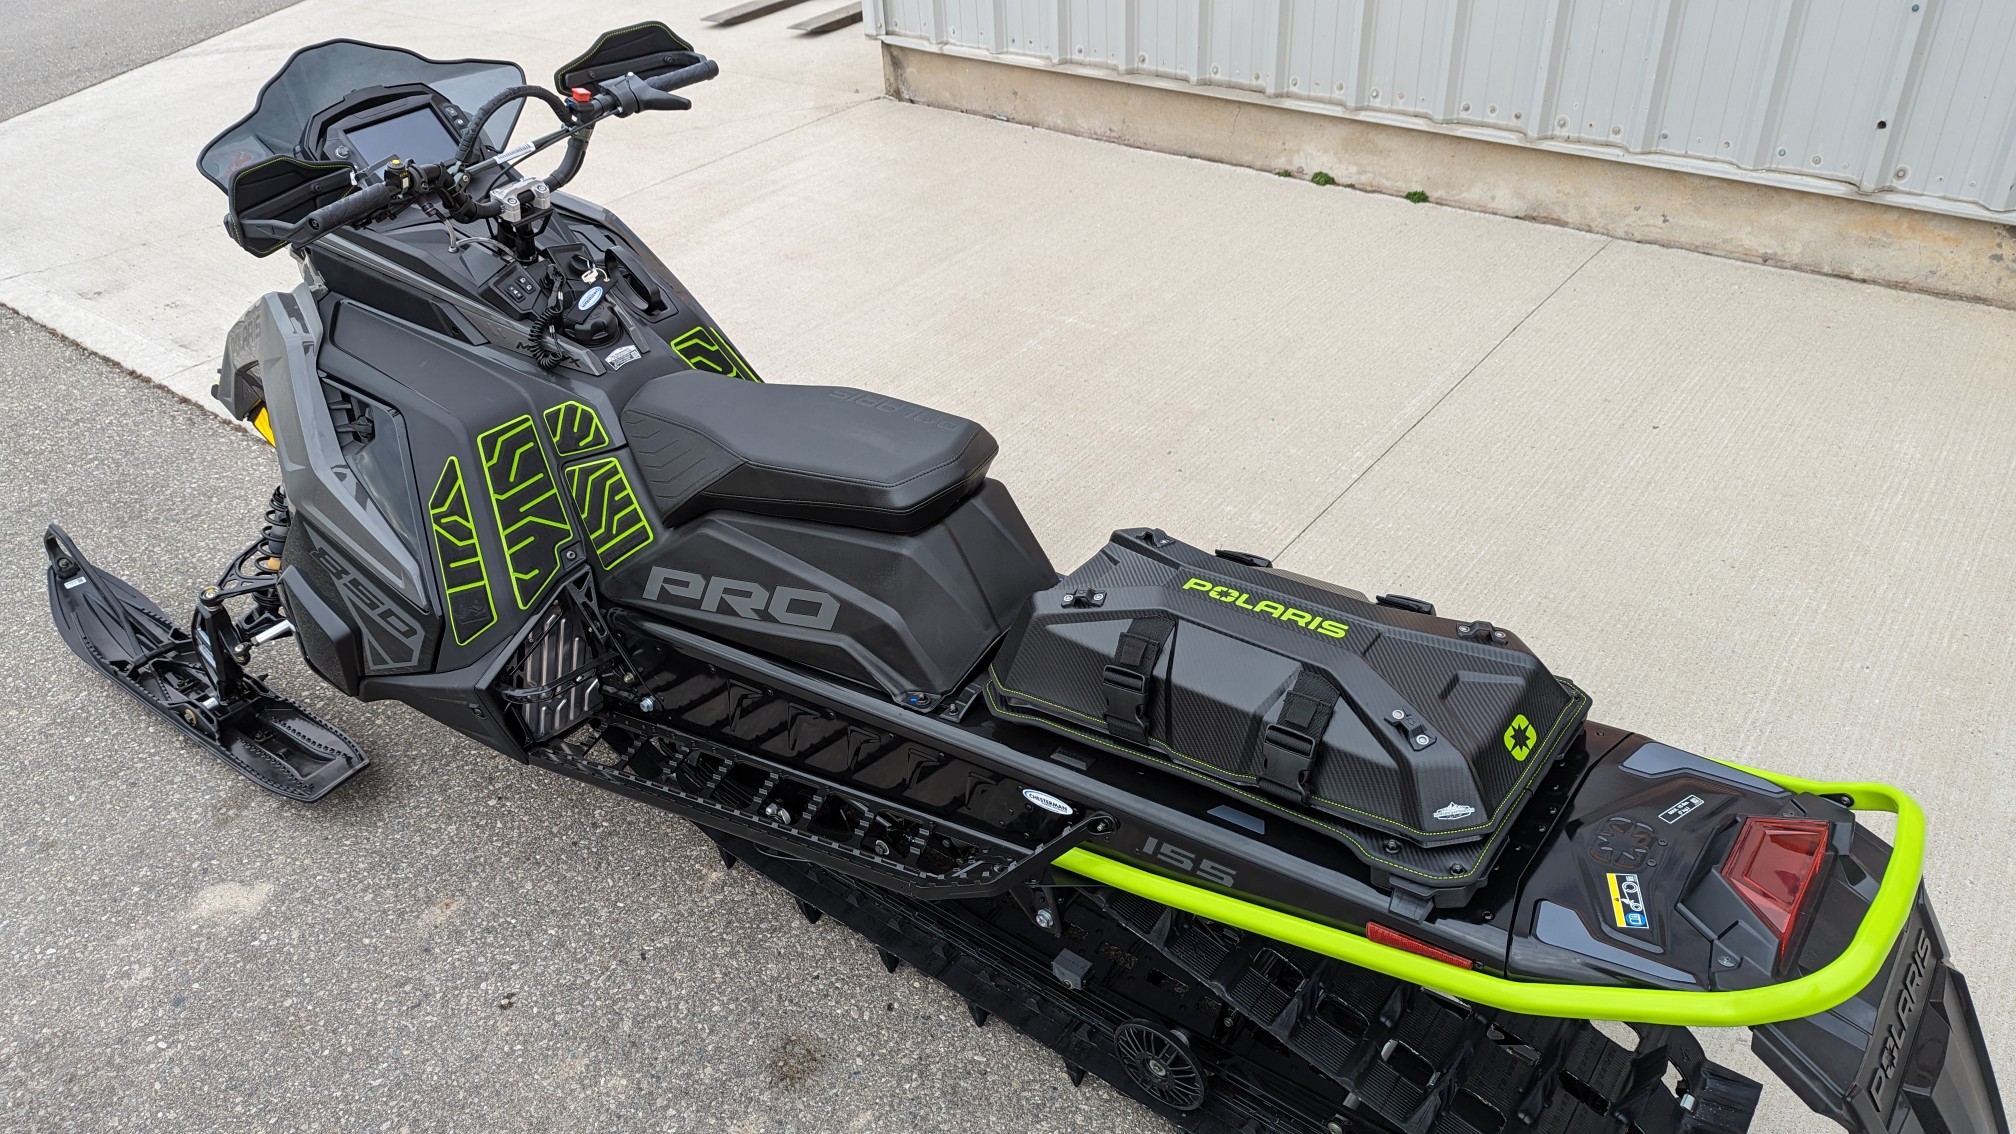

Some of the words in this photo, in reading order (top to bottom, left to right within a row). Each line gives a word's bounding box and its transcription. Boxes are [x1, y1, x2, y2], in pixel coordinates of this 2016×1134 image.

[309, 546, 418, 640] 850
[641, 565, 841, 631] PRO
[1182, 577, 1350, 640] POLARIS
[1142, 836, 1237, 888] 155
[1869, 927, 1932, 1112] POLARIS
